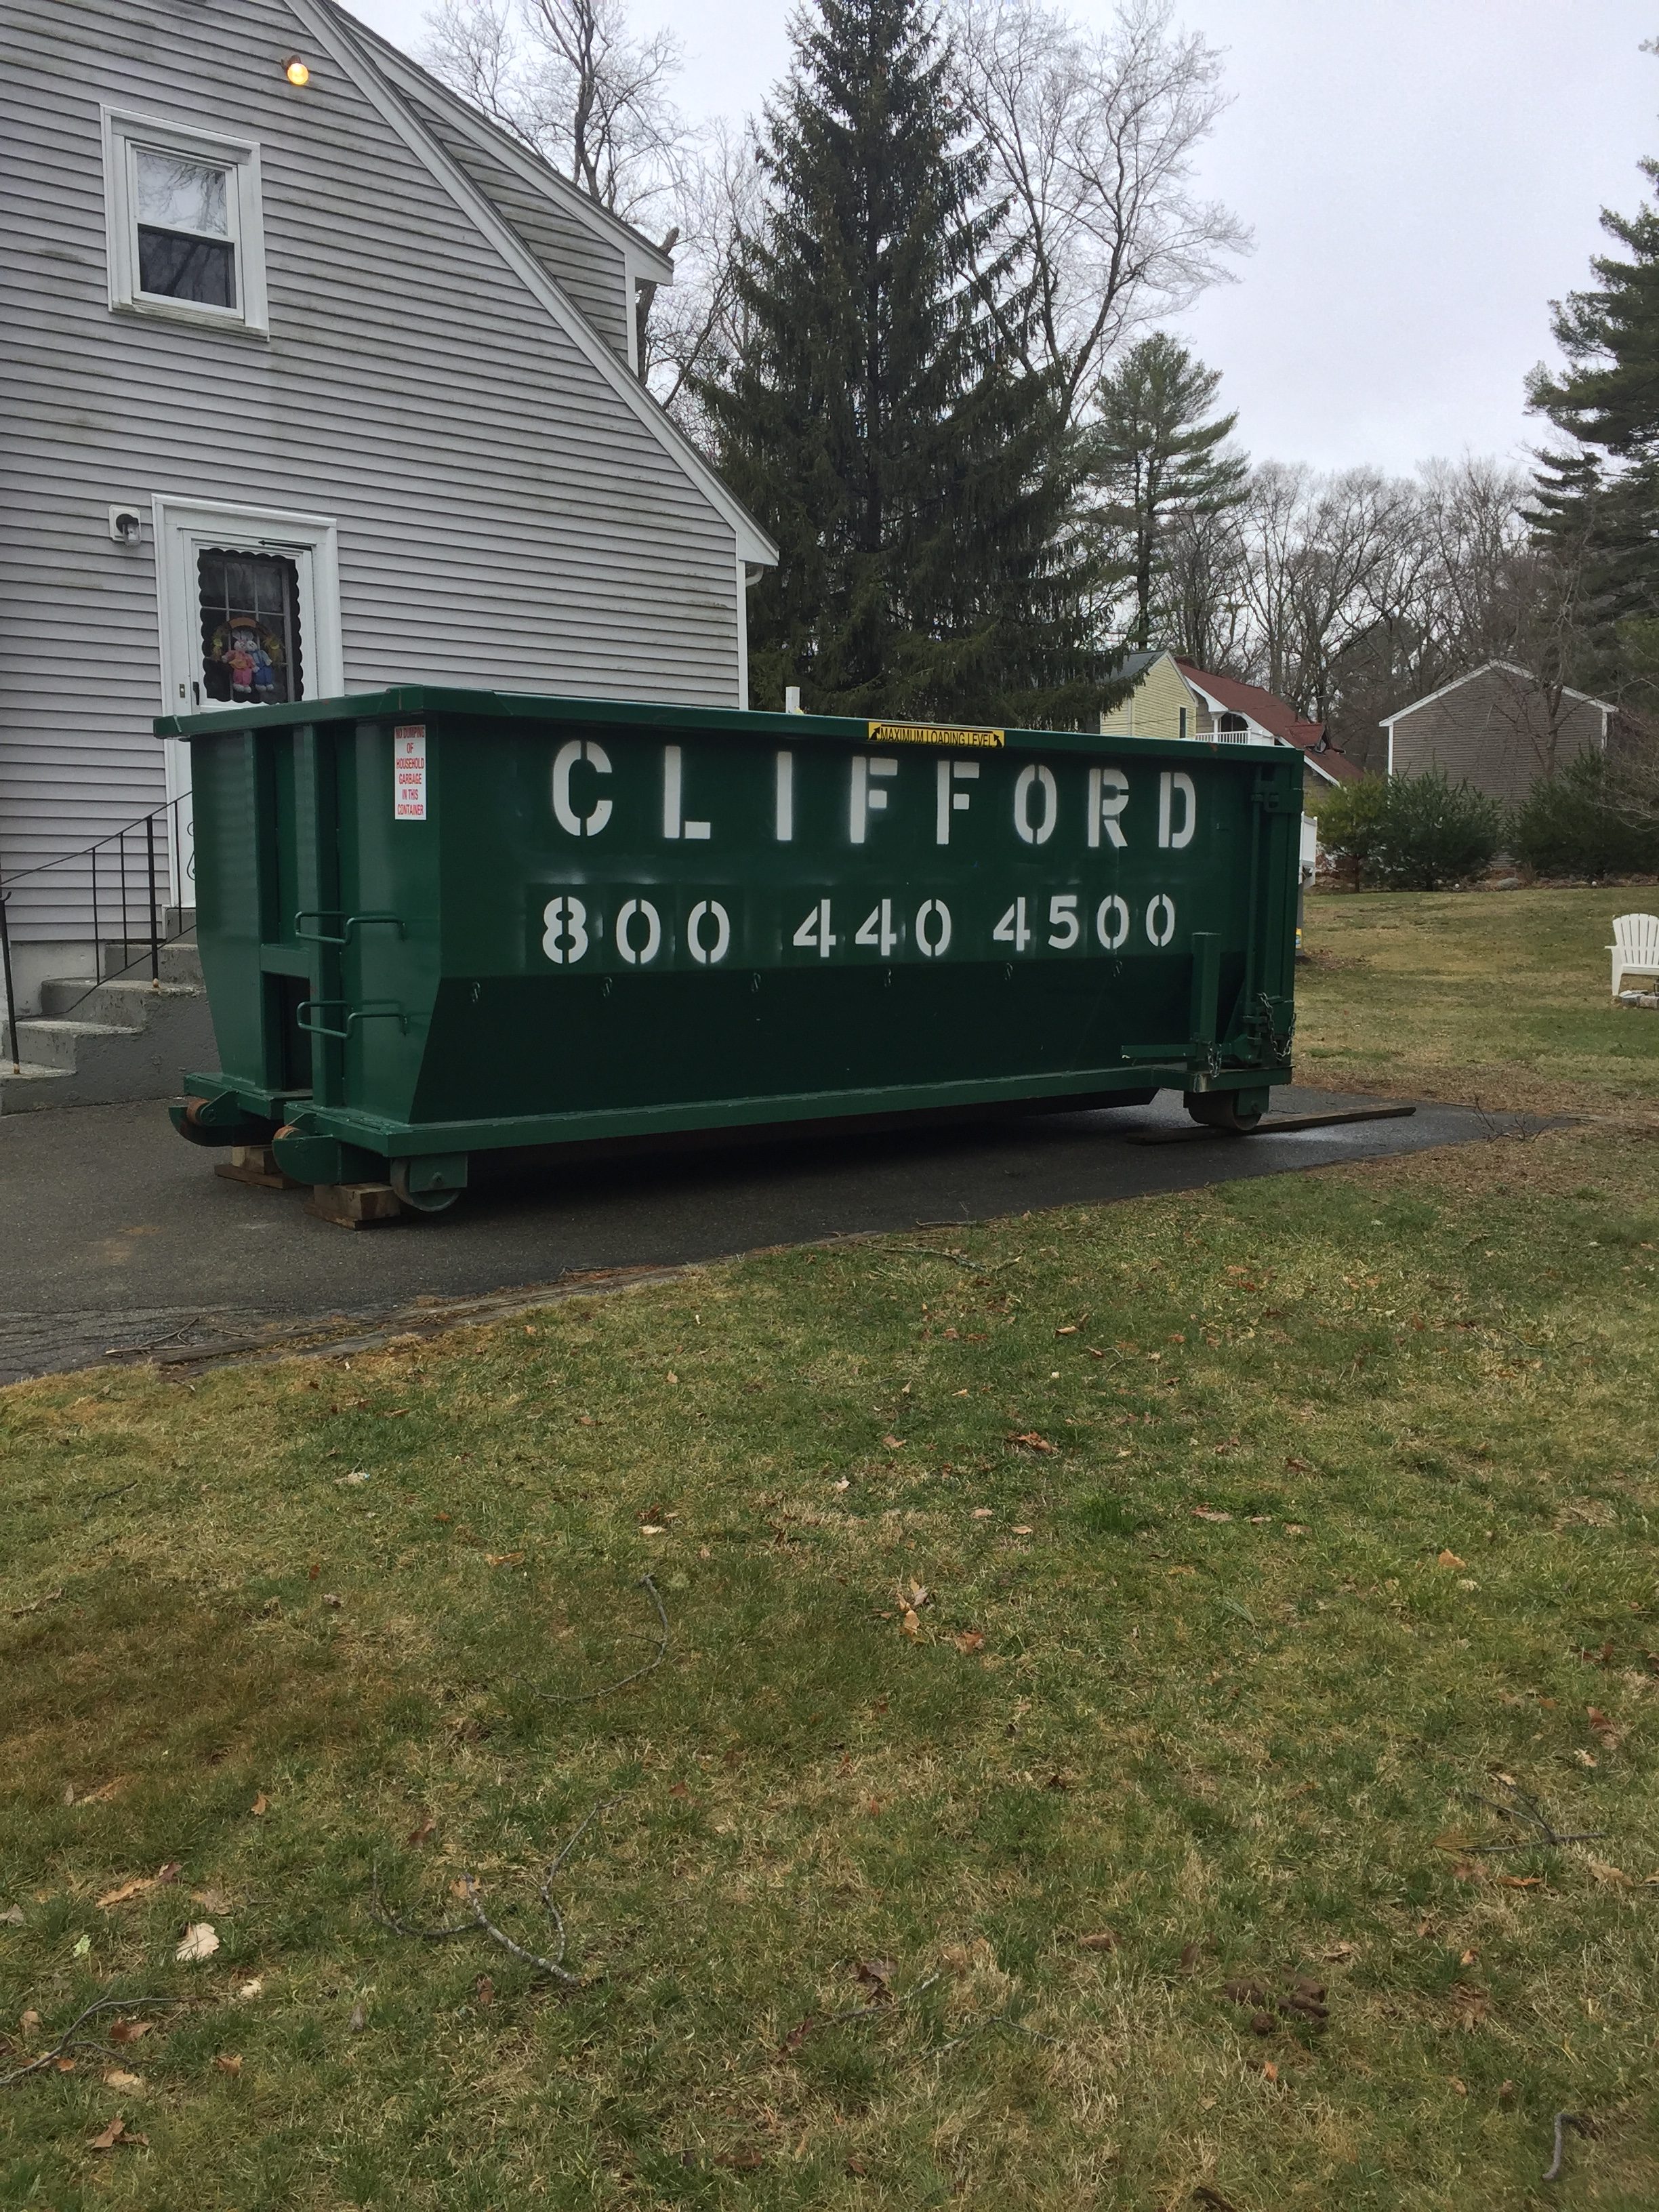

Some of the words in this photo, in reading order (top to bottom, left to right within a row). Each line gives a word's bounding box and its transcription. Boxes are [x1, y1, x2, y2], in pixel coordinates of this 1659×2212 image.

[396, 727, 402, 739] NO
[403, 726, 424, 739] DUMPING
[880, 727, 924, 741] MAXIMUM
[926, 731, 965, 745] LOADING
[967, 733, 993, 747] LEVEL
[407, 743, 414, 754] OF
[396, 758, 424, 769] HOUSEHOLD
[398, 773, 422, 785] GARBAGE
[402, 789, 407, 800] IN
[408, 789, 419, 800] THIS
[552, 739, 1197, 849] CLIFFORD
[397, 804, 424, 815] CONTAINER
[543, 895, 731, 965] 800
[792, 897, 951, 958] 440
[992, 893, 1176, 951] 4500
